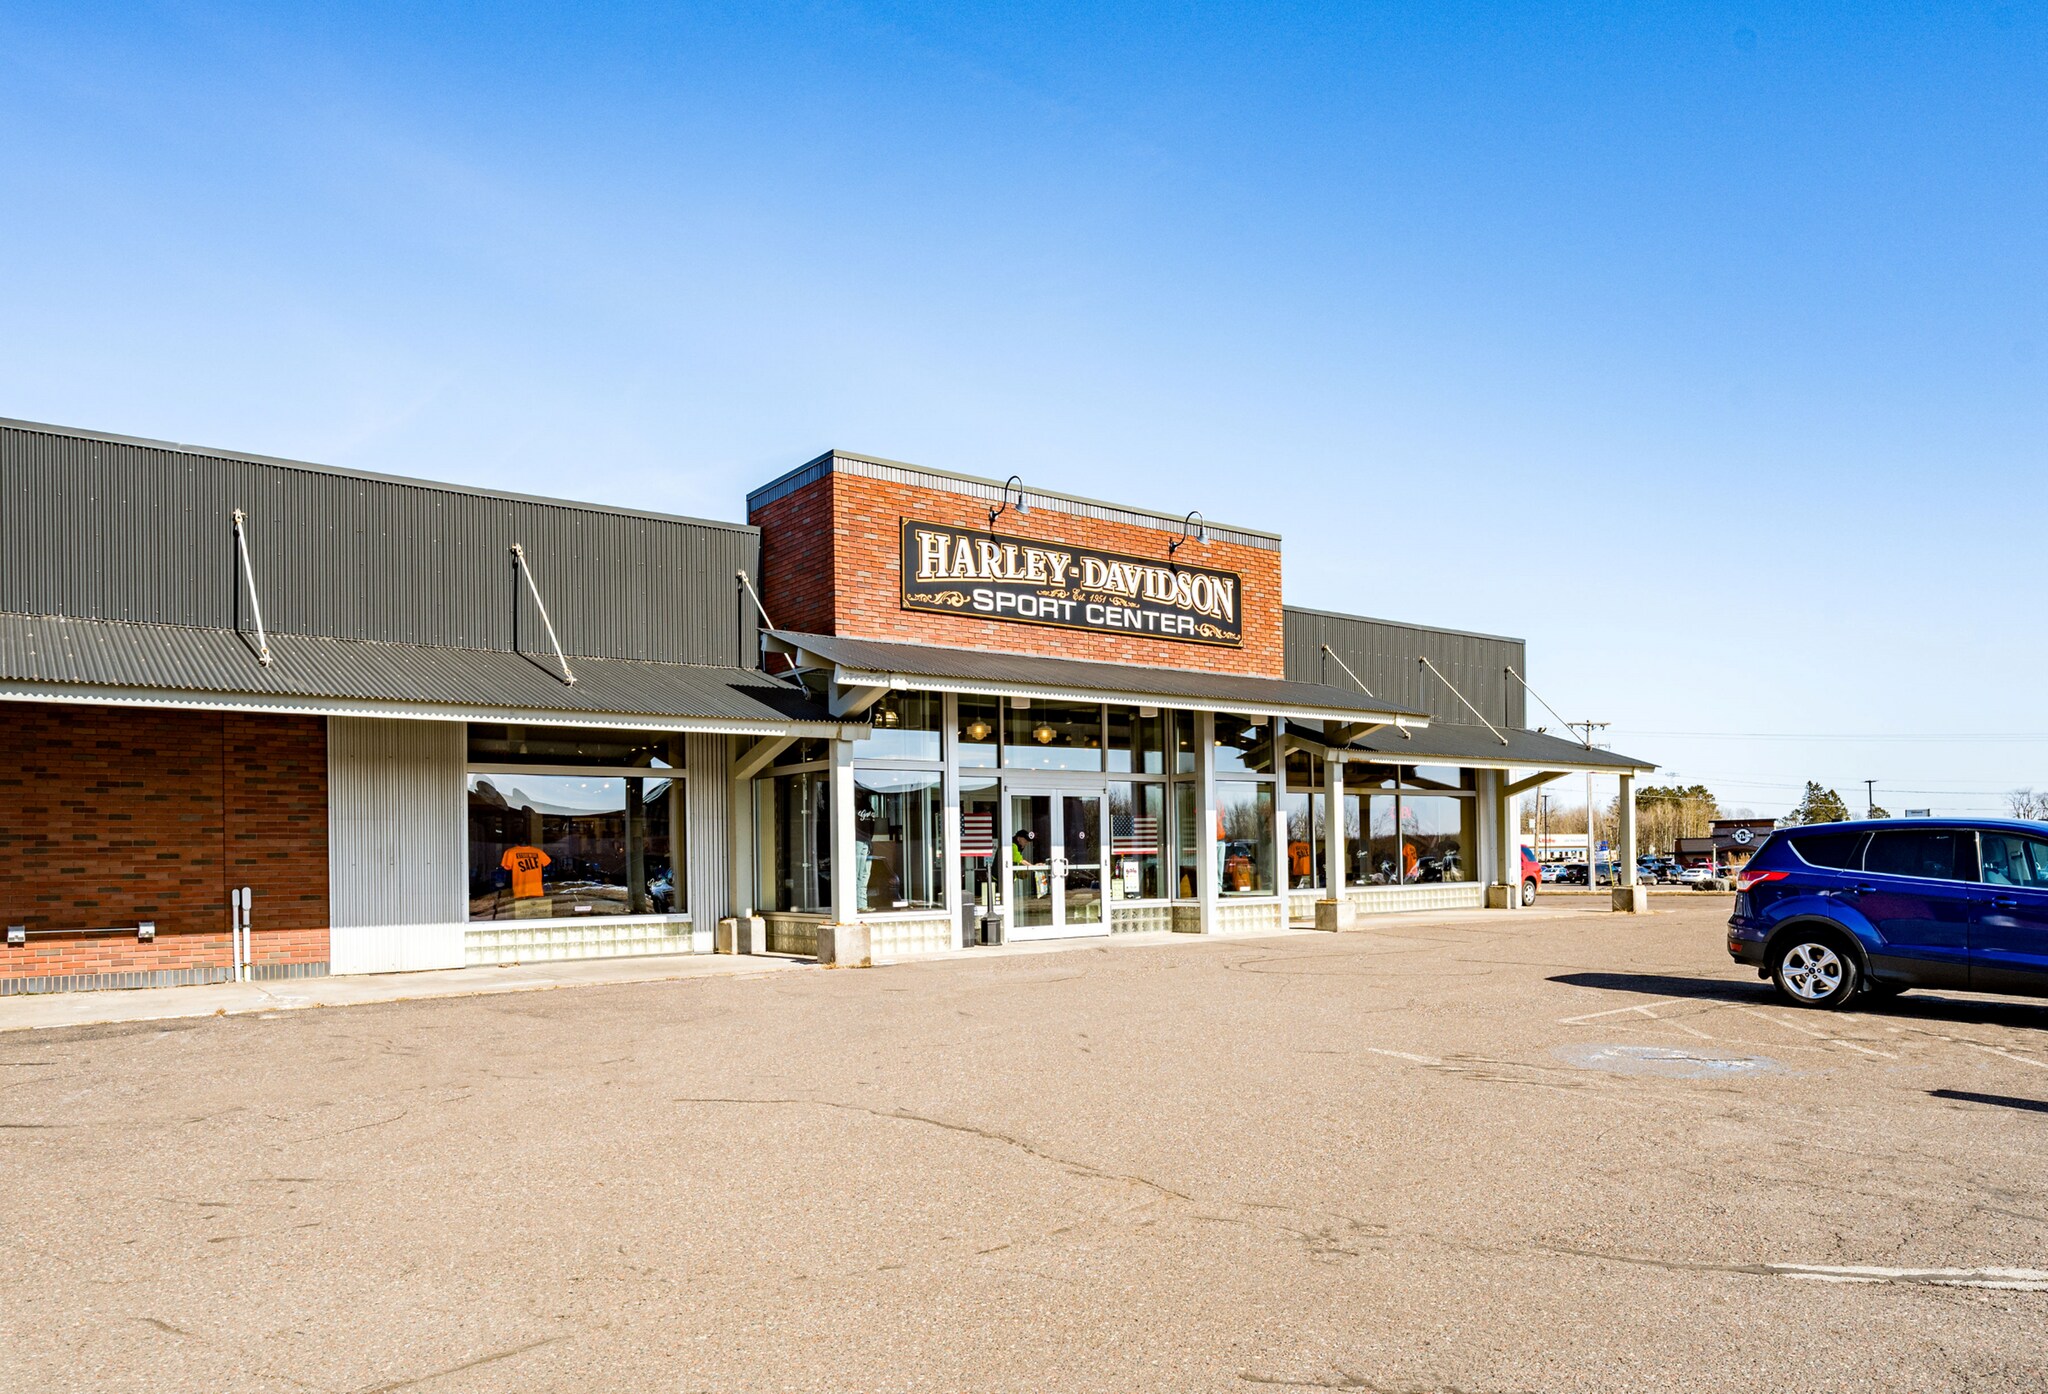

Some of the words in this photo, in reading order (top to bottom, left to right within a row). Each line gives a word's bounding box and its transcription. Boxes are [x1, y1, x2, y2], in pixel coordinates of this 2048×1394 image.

[915, 530, 1234, 623] HARLEY-DAVIDSON
[972, 588, 1077, 621] SPORT
[1085, 603, 1195, 636] CENTER
[1089, 593, 1107, 604] 1951
[518, 858, 538, 872] SALE
